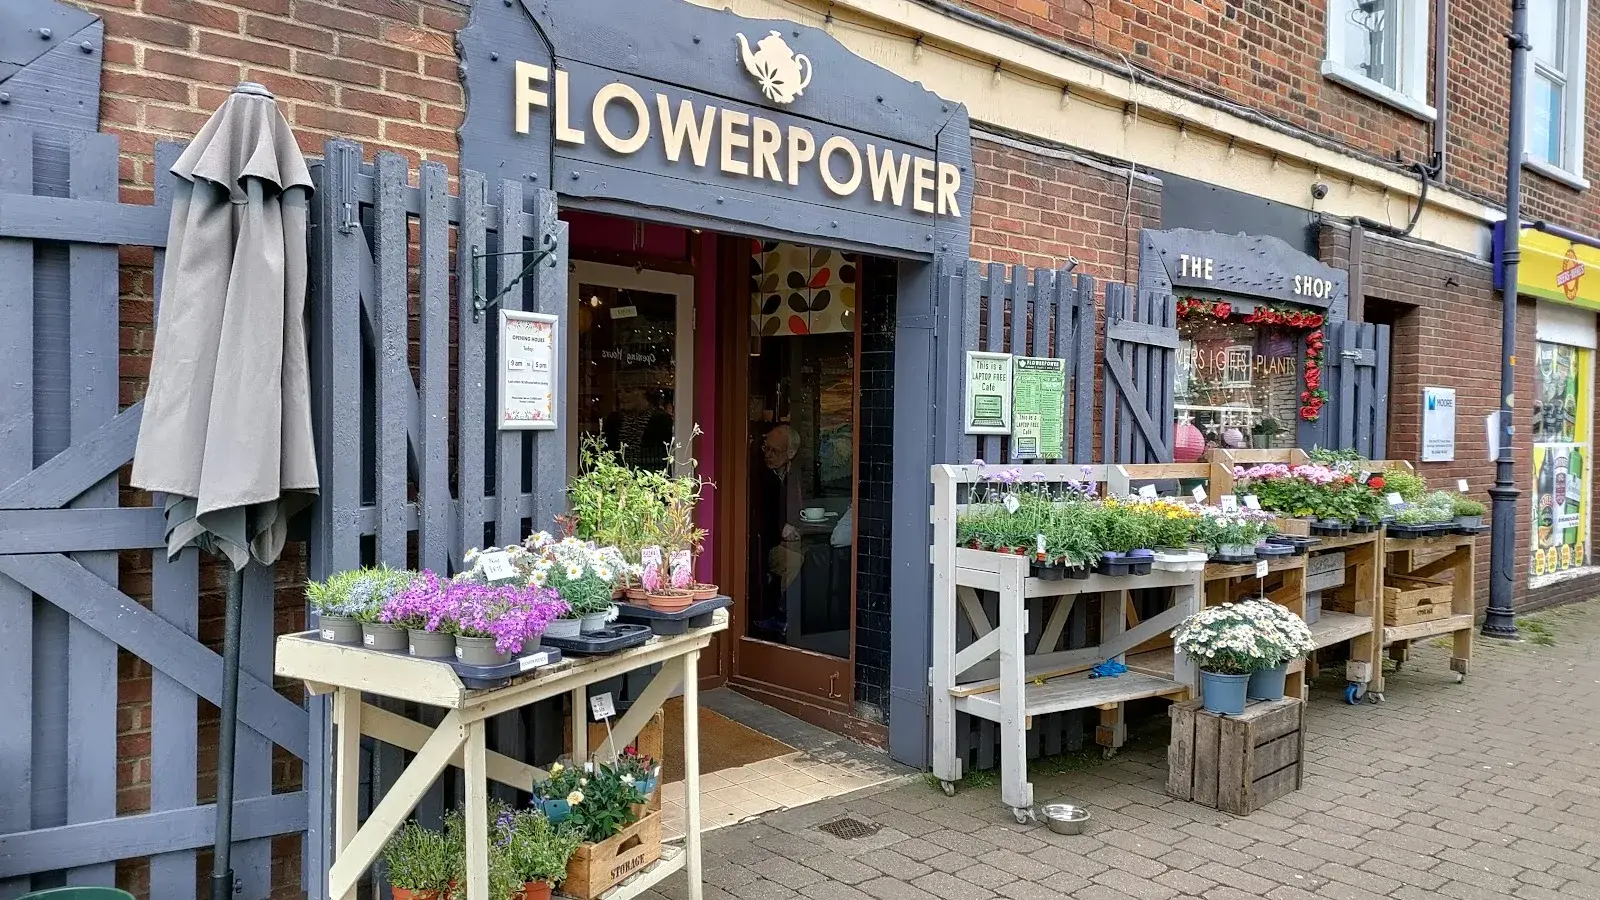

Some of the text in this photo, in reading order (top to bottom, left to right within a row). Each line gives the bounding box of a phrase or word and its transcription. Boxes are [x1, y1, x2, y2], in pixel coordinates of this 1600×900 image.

[514, 60, 962, 218] FLOWERPOWER
[1180, 254, 1332, 298] THE SHOP
[976, 361, 989, 370] This
[991, 362, 997, 370] is
[1257, 354, 1296, 375] PLANTS
[972, 372, 992, 380] LAPTOP
[982, 382, 995, 392] Café
[1437, 398, 1453, 407] MOORE
[610, 853, 645, 880] STORAGE
